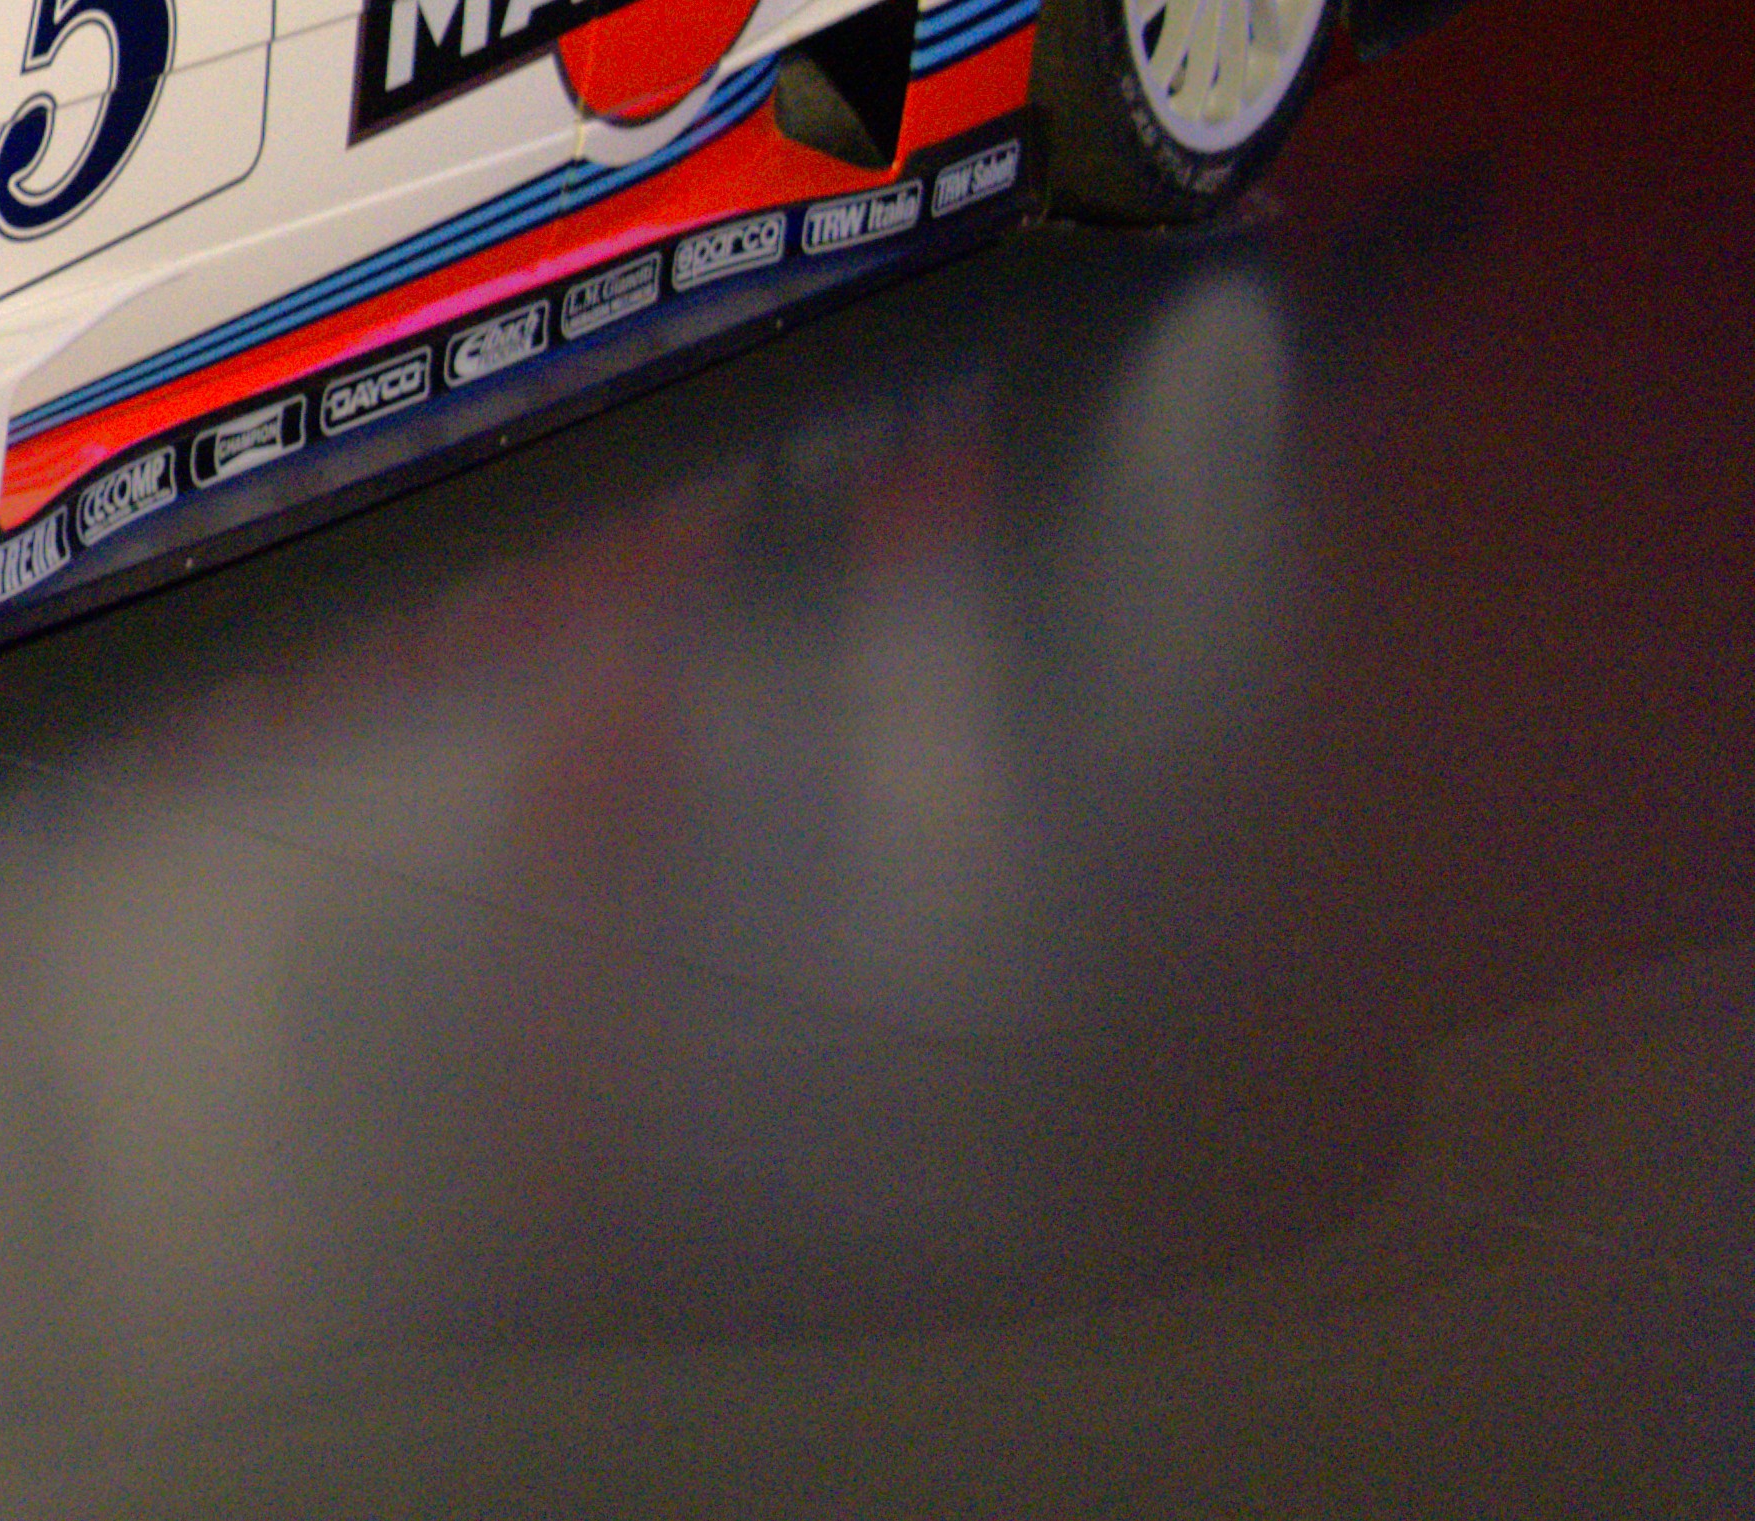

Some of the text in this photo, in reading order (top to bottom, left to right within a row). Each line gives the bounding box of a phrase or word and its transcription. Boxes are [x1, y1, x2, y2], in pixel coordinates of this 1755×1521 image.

[809, 202, 869, 247] TRW
[329, 360, 426, 422] DAYCO
[219, 415, 280, 459] CHAMPION
[83, 454, 167, 526] CECOMP
